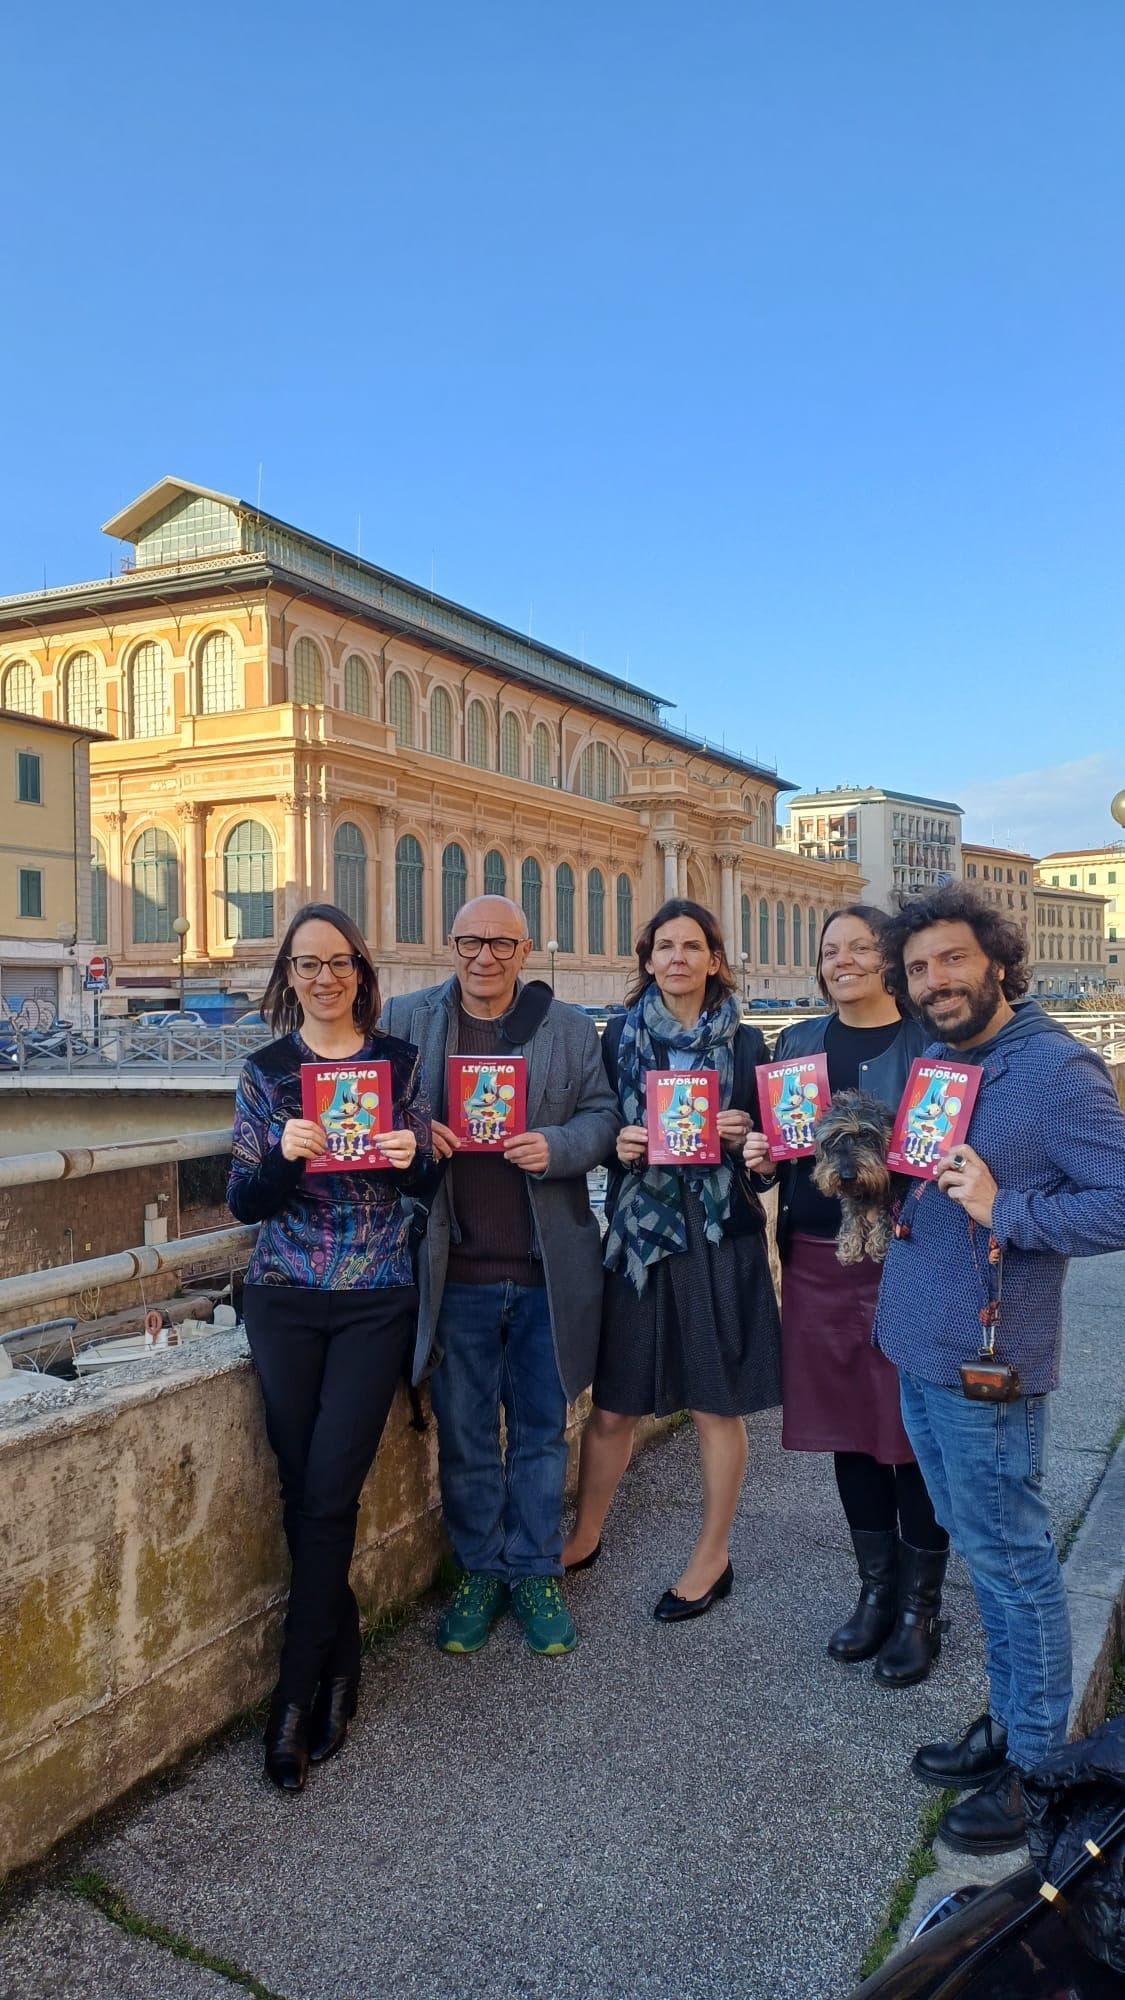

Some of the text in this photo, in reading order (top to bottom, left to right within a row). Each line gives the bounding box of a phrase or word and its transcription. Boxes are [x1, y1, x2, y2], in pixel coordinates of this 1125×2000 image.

[462, 1065, 515, 1073] LIVORNO
[767, 1063, 816, 1079] LIVORNO
[316, 1070, 378, 1081] LIVORNO
[918, 1067, 968, 1083] LIVORNO
[657, 1077, 708, 1086] LIVORNO
